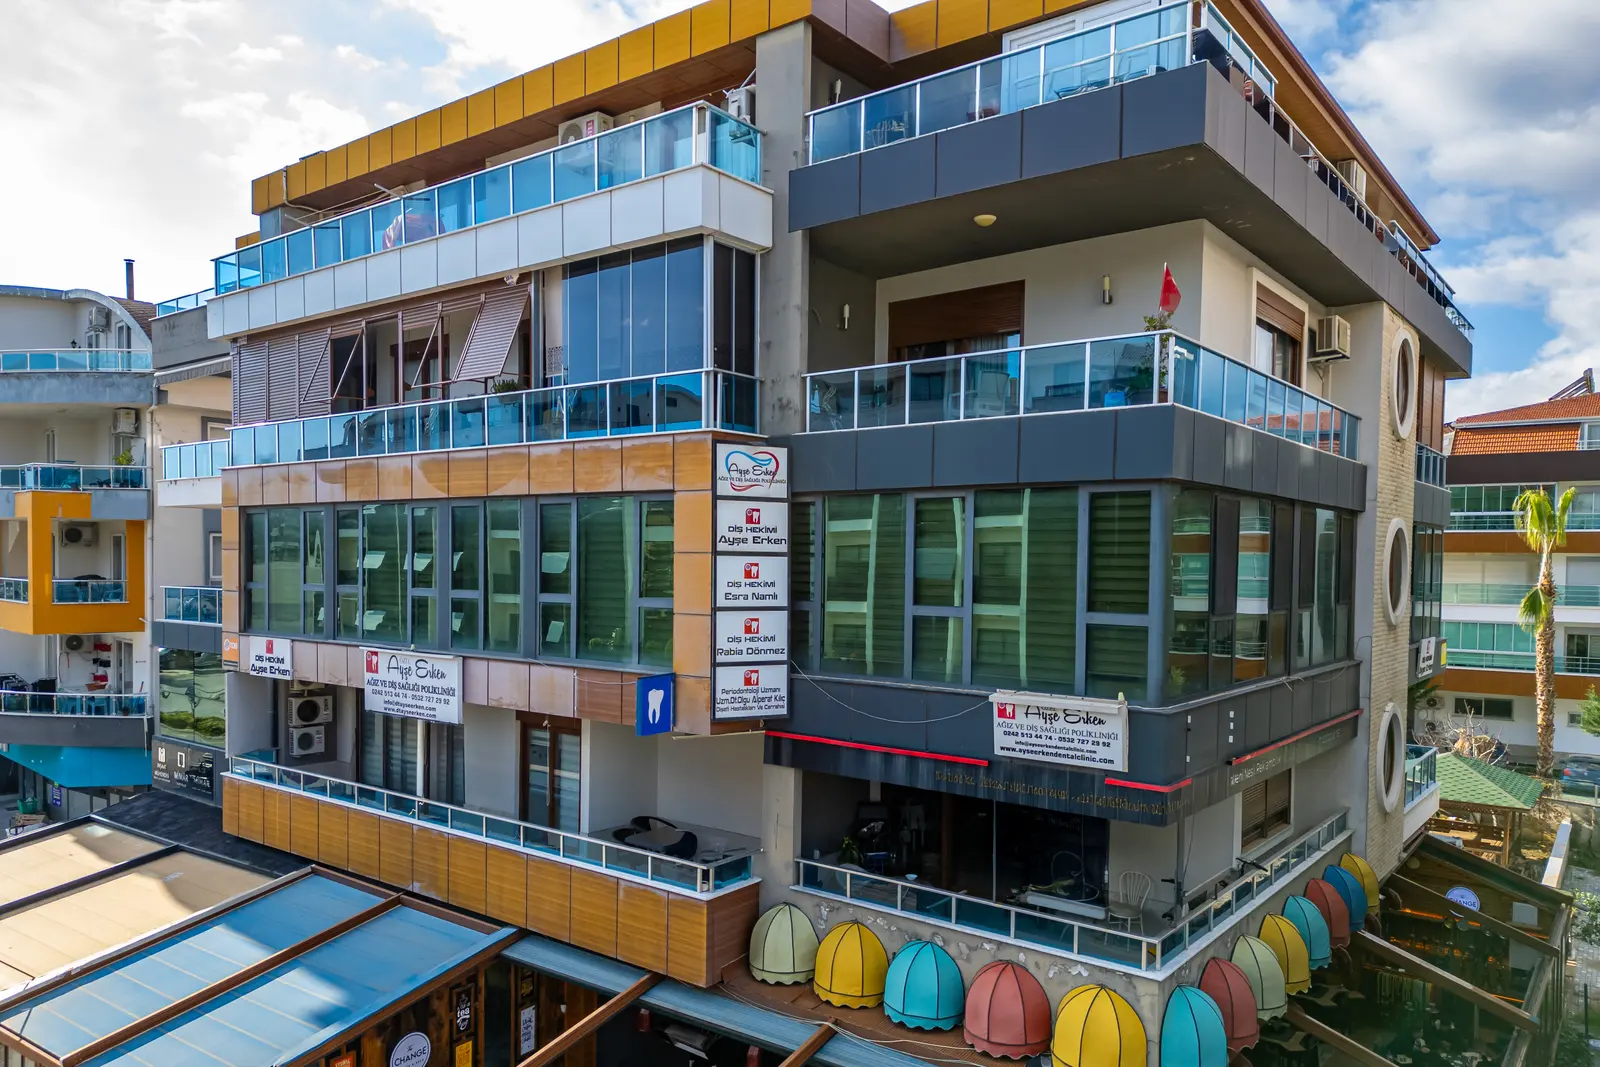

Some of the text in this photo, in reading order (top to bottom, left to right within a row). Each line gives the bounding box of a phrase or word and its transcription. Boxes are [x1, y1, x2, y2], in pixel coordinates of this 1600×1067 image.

[728, 463, 777, 476] Ayşe Erken
[728, 524, 777, 534] DİŞ HEKİMİ
[718, 536, 787, 546] Ayşe Erken
[727, 580, 776, 589] DİŞ HEKİMİ
[724, 592, 778, 601] Esra Namlı
[727, 634, 776, 644] DİŞ HEKİMİ
[717, 646, 785, 656] Rabia Dönmez
[255, 654, 284, 664] DİŞ HEKİMİ
[251, 664, 291, 676] Ayşe Erken
[387, 655, 446, 681] Ayşe Erken
[367, 677, 456, 697] AĞIZ VE DİŞ SAĞLIĞI POLİKLİNİĞİ
[372, 688, 383, 696] 0242
[1024, 705, 1106, 726] Ayşe Erken
[997, 721, 1014, 729] AĞIZ
[1027, 724, 1038, 733] DİŞ
[1040, 726, 1070, 735] SAĞLIĞI
[1072, 729, 1118, 741] POLİKLİNİĞİ
[1000, 746, 1114, 765] www.ayseerkendentalclinic.com
[457, 1006, 470, 1018] tea
[395, 1046, 427, 1066] CHANGE
